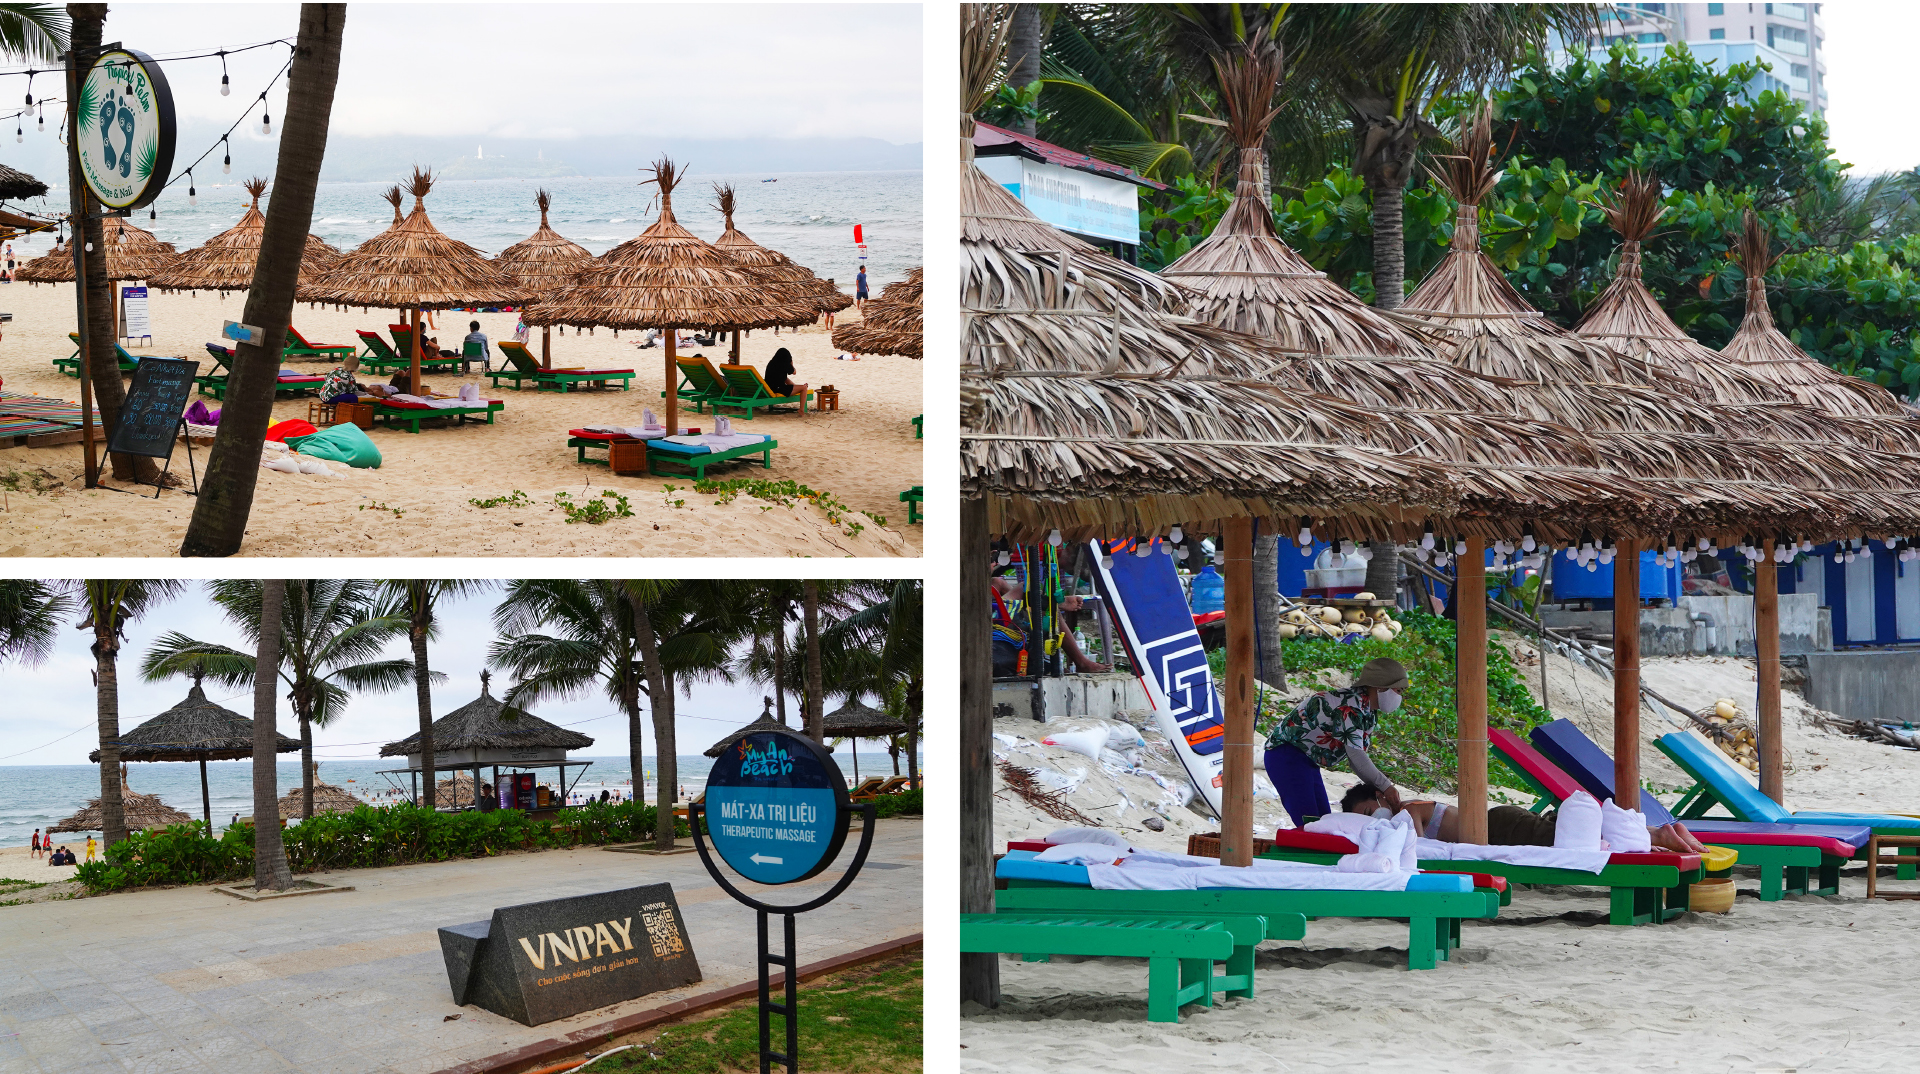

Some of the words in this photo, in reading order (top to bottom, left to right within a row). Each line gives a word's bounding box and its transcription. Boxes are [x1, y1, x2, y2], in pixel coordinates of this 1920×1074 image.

[134, 73, 150, 113] Palm
[90, 171, 113, 198] Massage
[113, 189, 119, 199] &
[119, 185, 133, 198] Nail
[766, 741, 788, 761] An
[740, 759, 793, 778] Beach
[721, 799, 765, 820] MÁT-XA
[767, 804, 787, 825] TRỊ
[789, 802, 817, 826] LIỆU
[721, 824, 774, 840] THERAPEUTIC
[775, 828, 817, 843] MASSAGE
[641, 901, 668, 912] VNPAYQR
[518, 916, 635, 971] VNPAY
[537, 974, 553, 987] Cho
[554, 972, 572, 984] cuộc
[572, 964, 591, 979] sống
[592, 964, 607, 974] đơn
[625, 956, 639, 966] hơn
